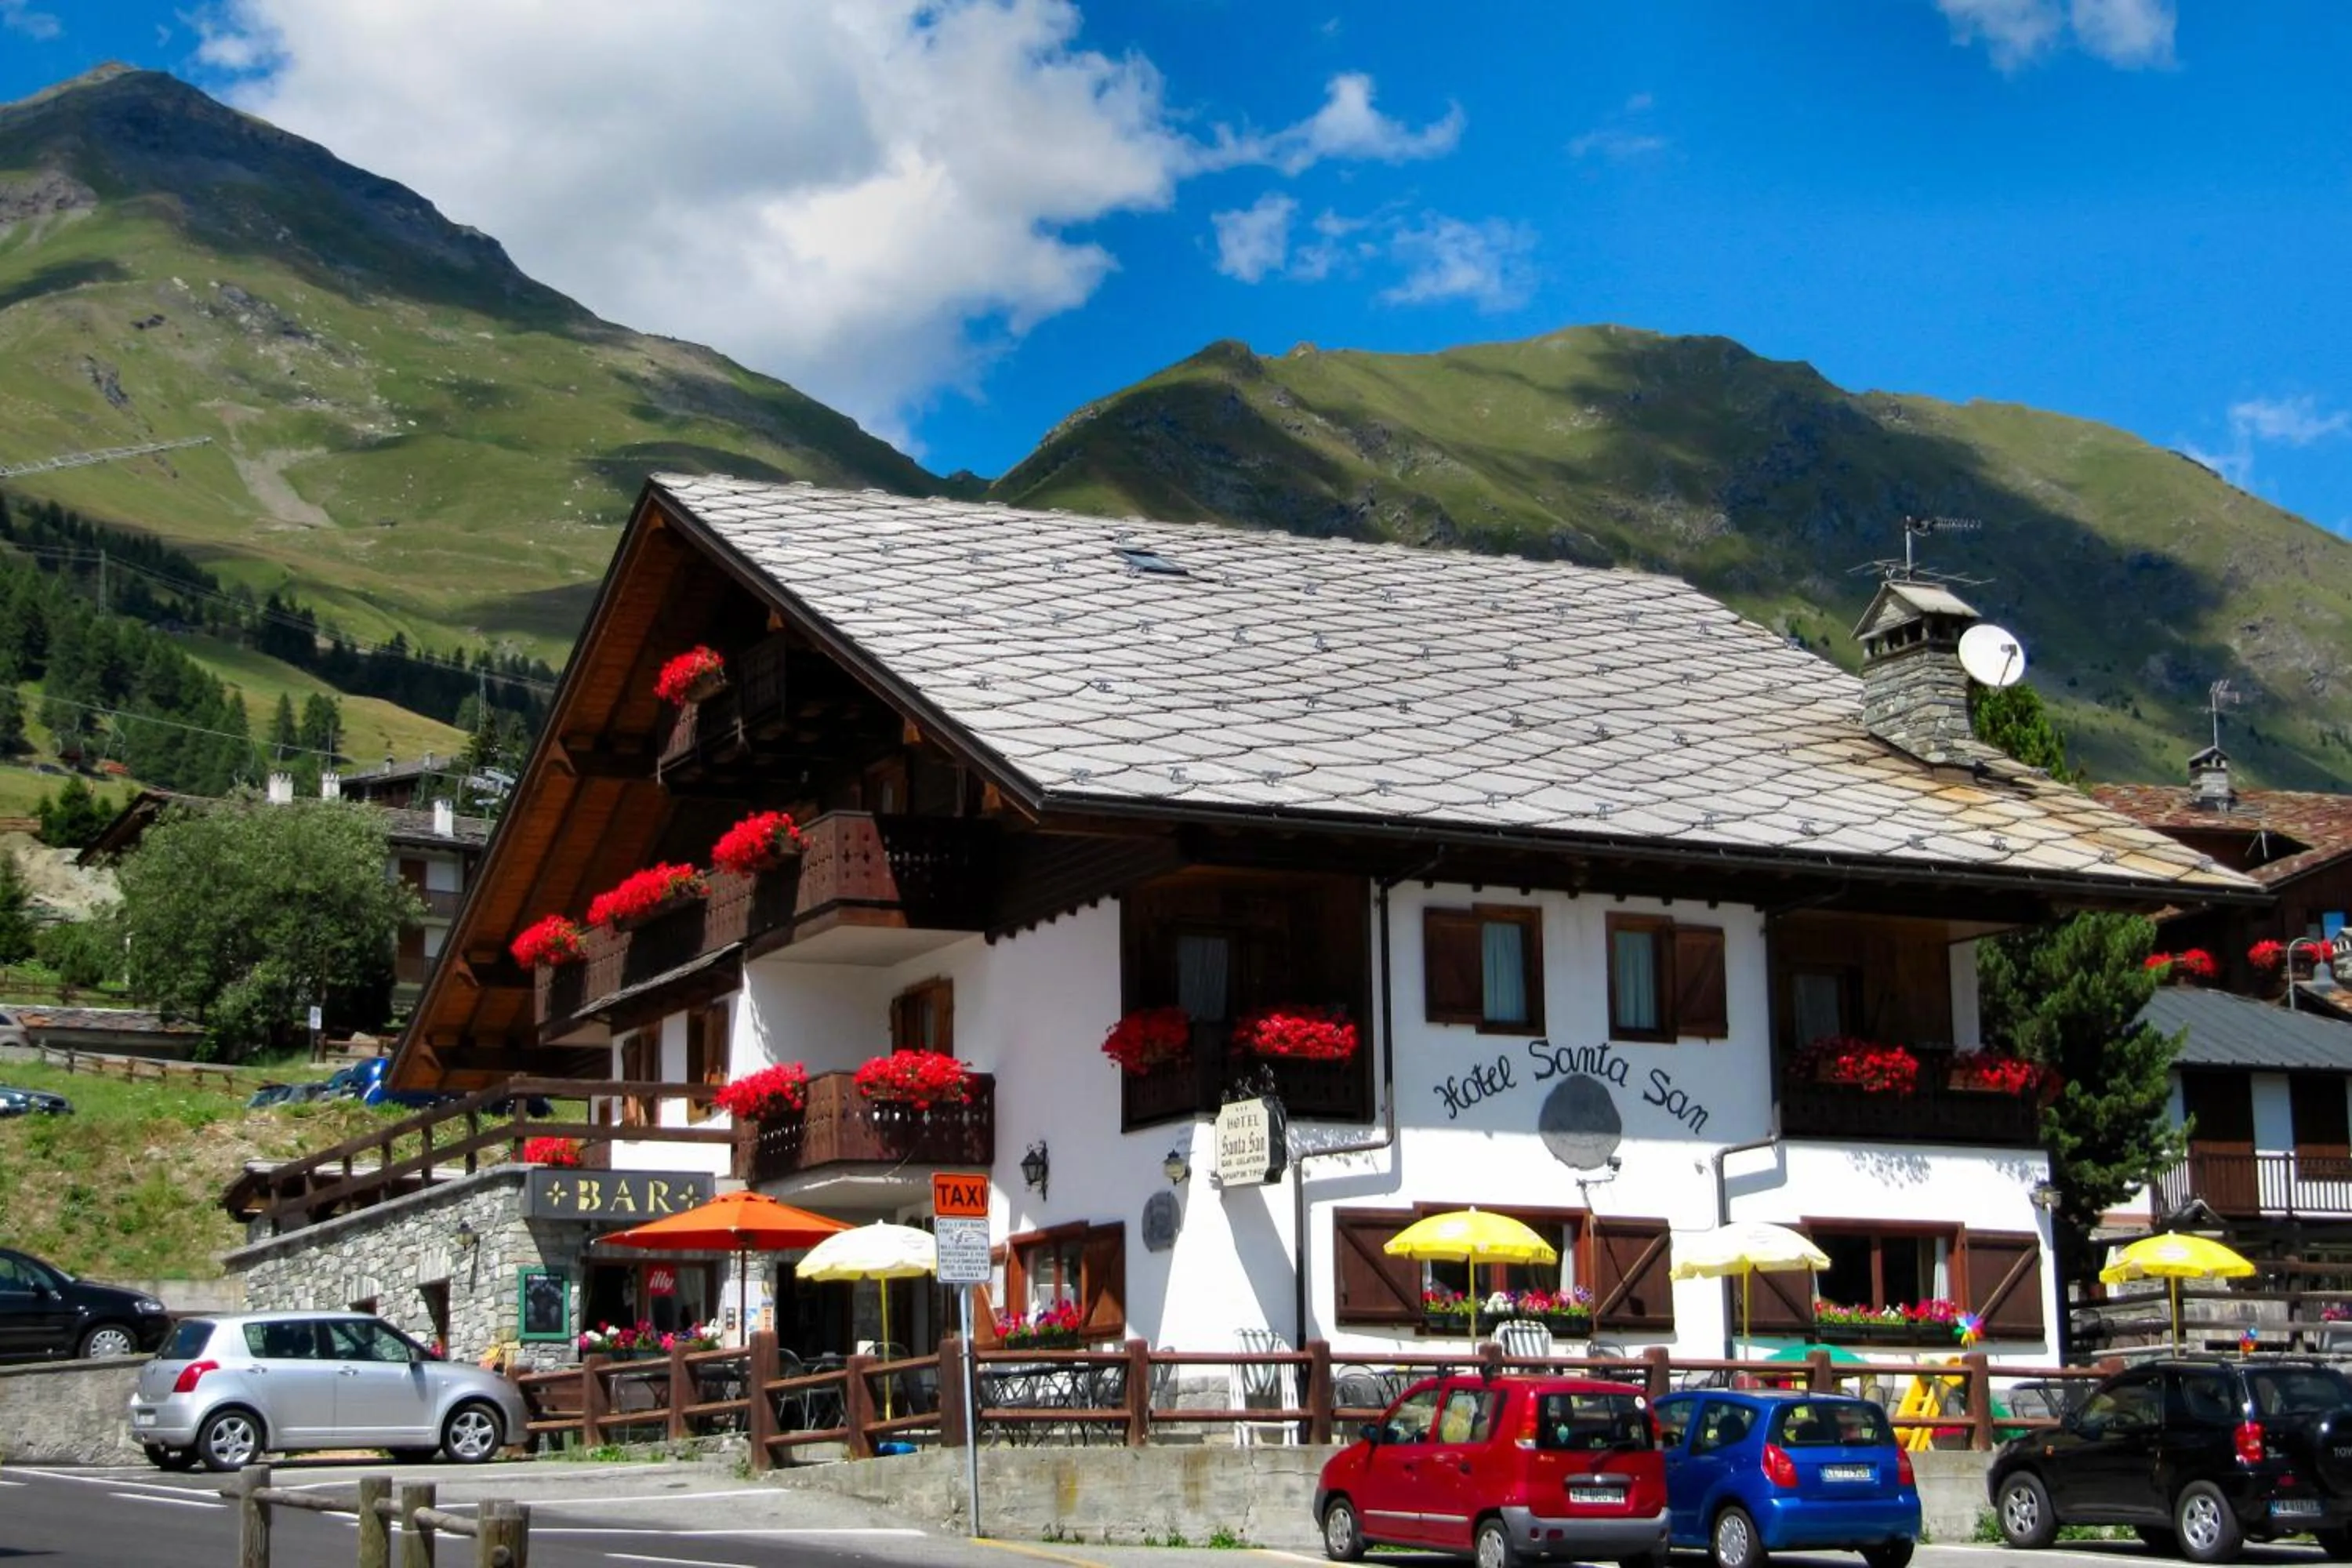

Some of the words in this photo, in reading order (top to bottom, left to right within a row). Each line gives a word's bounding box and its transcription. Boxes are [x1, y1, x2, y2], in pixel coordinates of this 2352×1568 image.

[1433, 1054, 1517, 1120] Hotel
[1529, 1039, 1629, 1087] Santa
[1643, 1068, 1708, 1134] San
[1227, 1114, 1260, 1130] HOTEL
[1221, 1134, 1247, 1157] Santa
[1249, 1131, 1265, 1153] San
[578, 1179, 674, 1213] BAR
[937, 1183, 985, 1207] TAXI
[649, 1270, 675, 1293] illy
